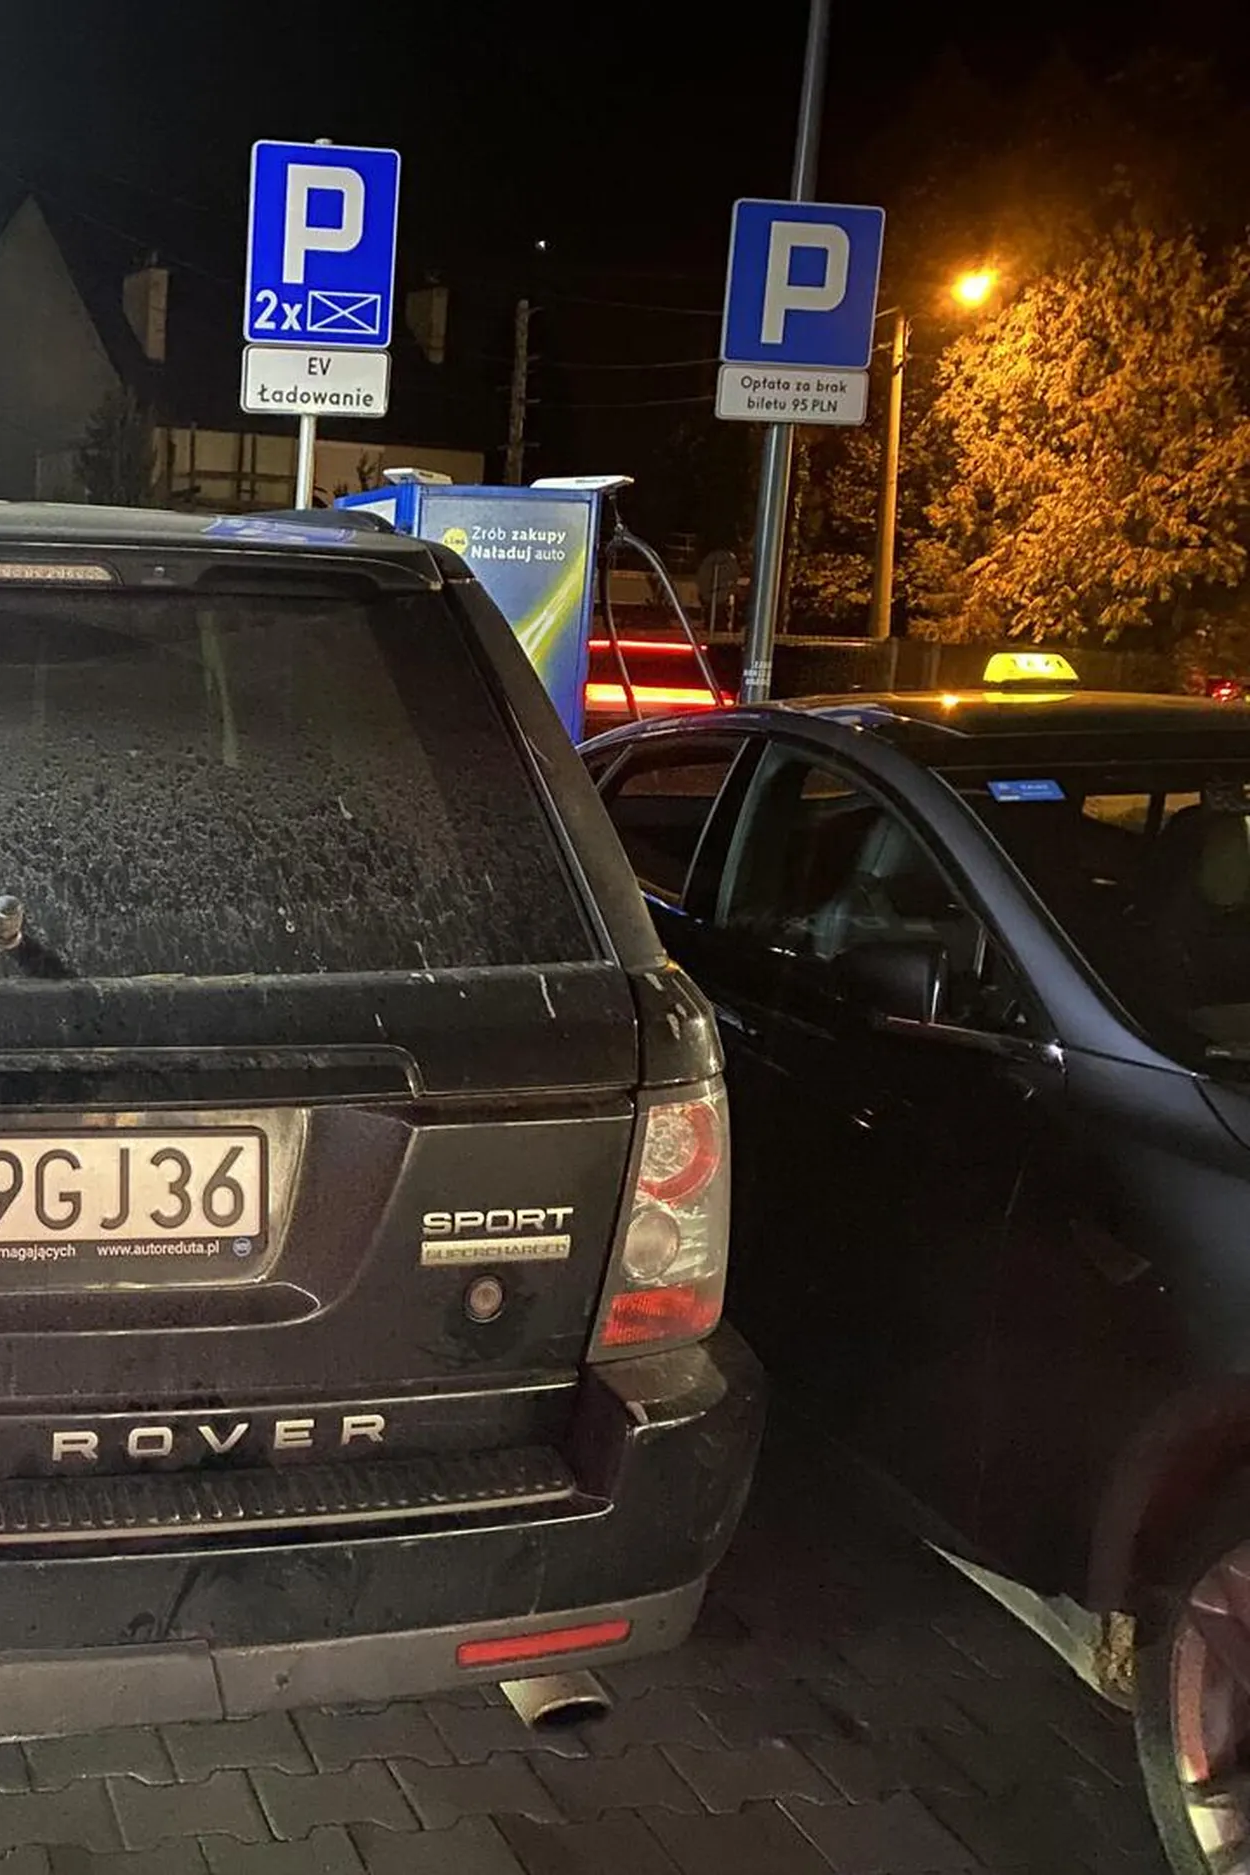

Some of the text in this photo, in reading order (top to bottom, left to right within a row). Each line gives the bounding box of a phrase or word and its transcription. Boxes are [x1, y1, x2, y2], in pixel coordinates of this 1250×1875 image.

[283, 164, 365, 284] P
[761, 220, 850, 345] P
[307, 357, 332, 376] EV
[258, 383, 374, 408] Ładowanie
[816, 379, 848, 393] brak
[747, 395, 838, 412] biletu 95 PLN
[471, 525, 507, 541] Zrób
[511, 527, 567, 545] zakupy
[471, 544, 566, 563] Naładuj auto
[422, 1206, 574, 1235] SPORT
[96, 1240, 220, 1256] www.autoreduta.pl
[52, 1414, 387, 1461] ROVER
